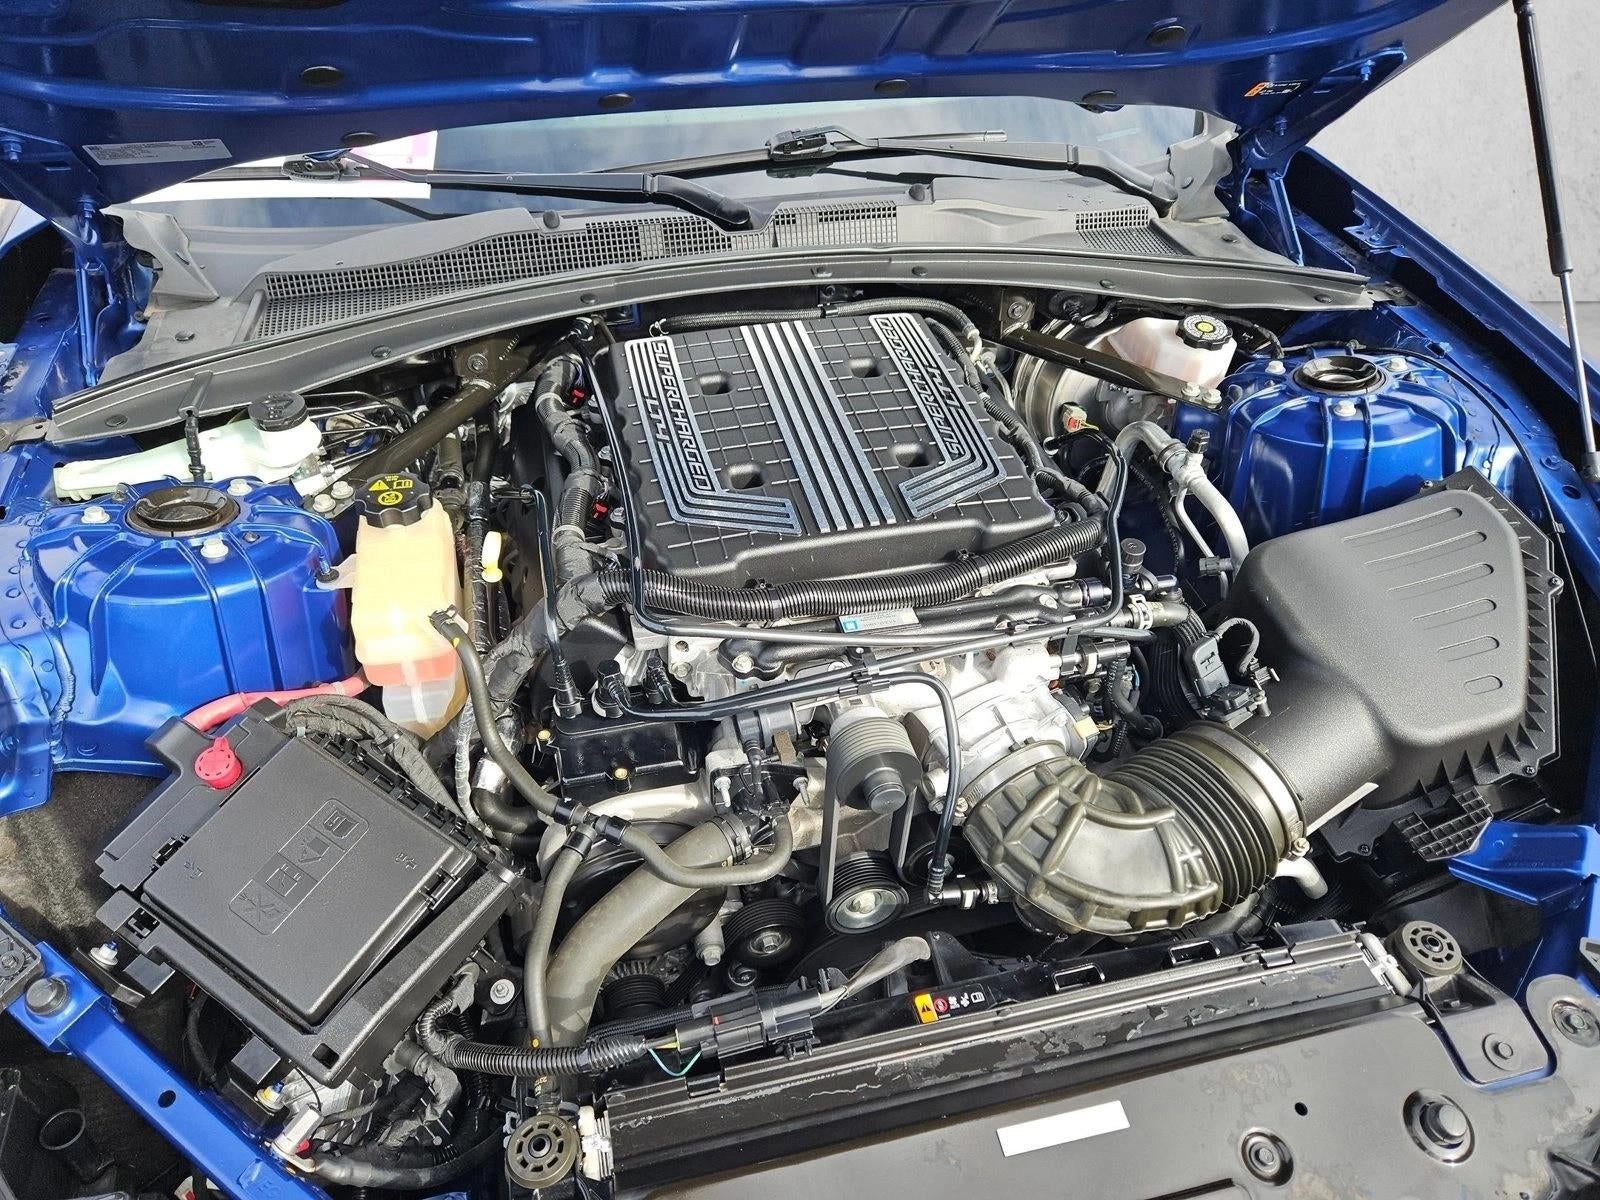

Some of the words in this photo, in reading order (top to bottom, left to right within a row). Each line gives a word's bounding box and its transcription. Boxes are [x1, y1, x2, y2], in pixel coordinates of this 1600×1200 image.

[645, 399, 670, 441] LT4
[651, 341, 712, 491] SUPERCHARGED
[879, 318, 964, 456] SUPERCHARGED
[926, 367, 961, 408] LT4
